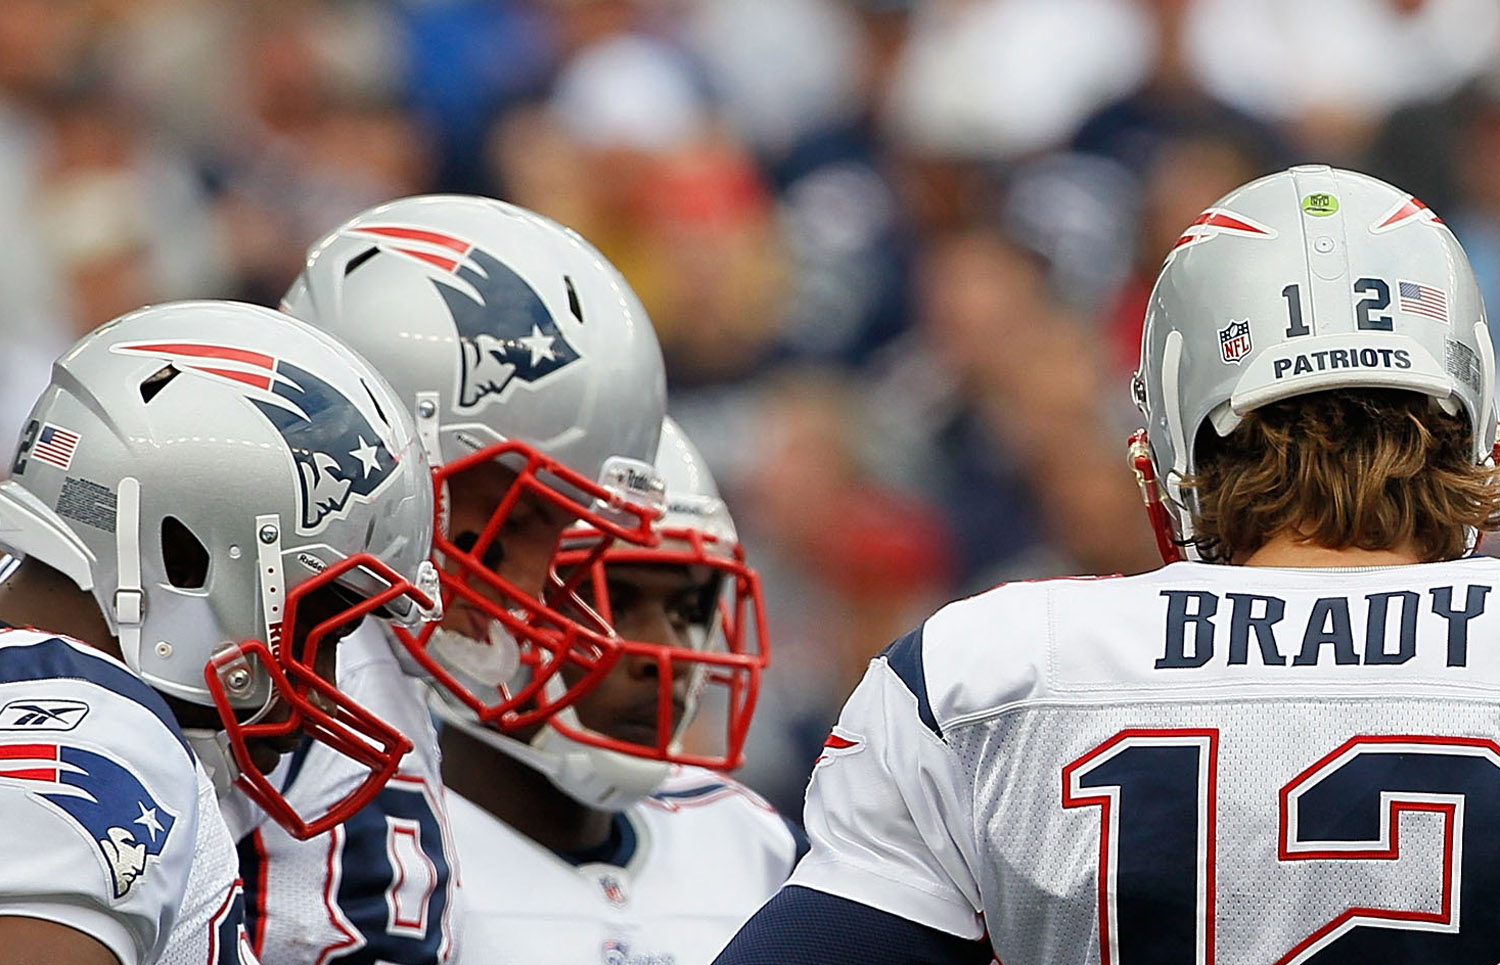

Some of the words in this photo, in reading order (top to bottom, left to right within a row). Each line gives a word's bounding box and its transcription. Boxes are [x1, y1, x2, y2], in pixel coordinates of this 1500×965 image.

[1224, 336, 1251, 360] NFL
[1273, 348, 1412, 379] PATRIOTS
[299, 554, 329, 574] Ridde
[1155, 585, 1492, 669] BRADY
